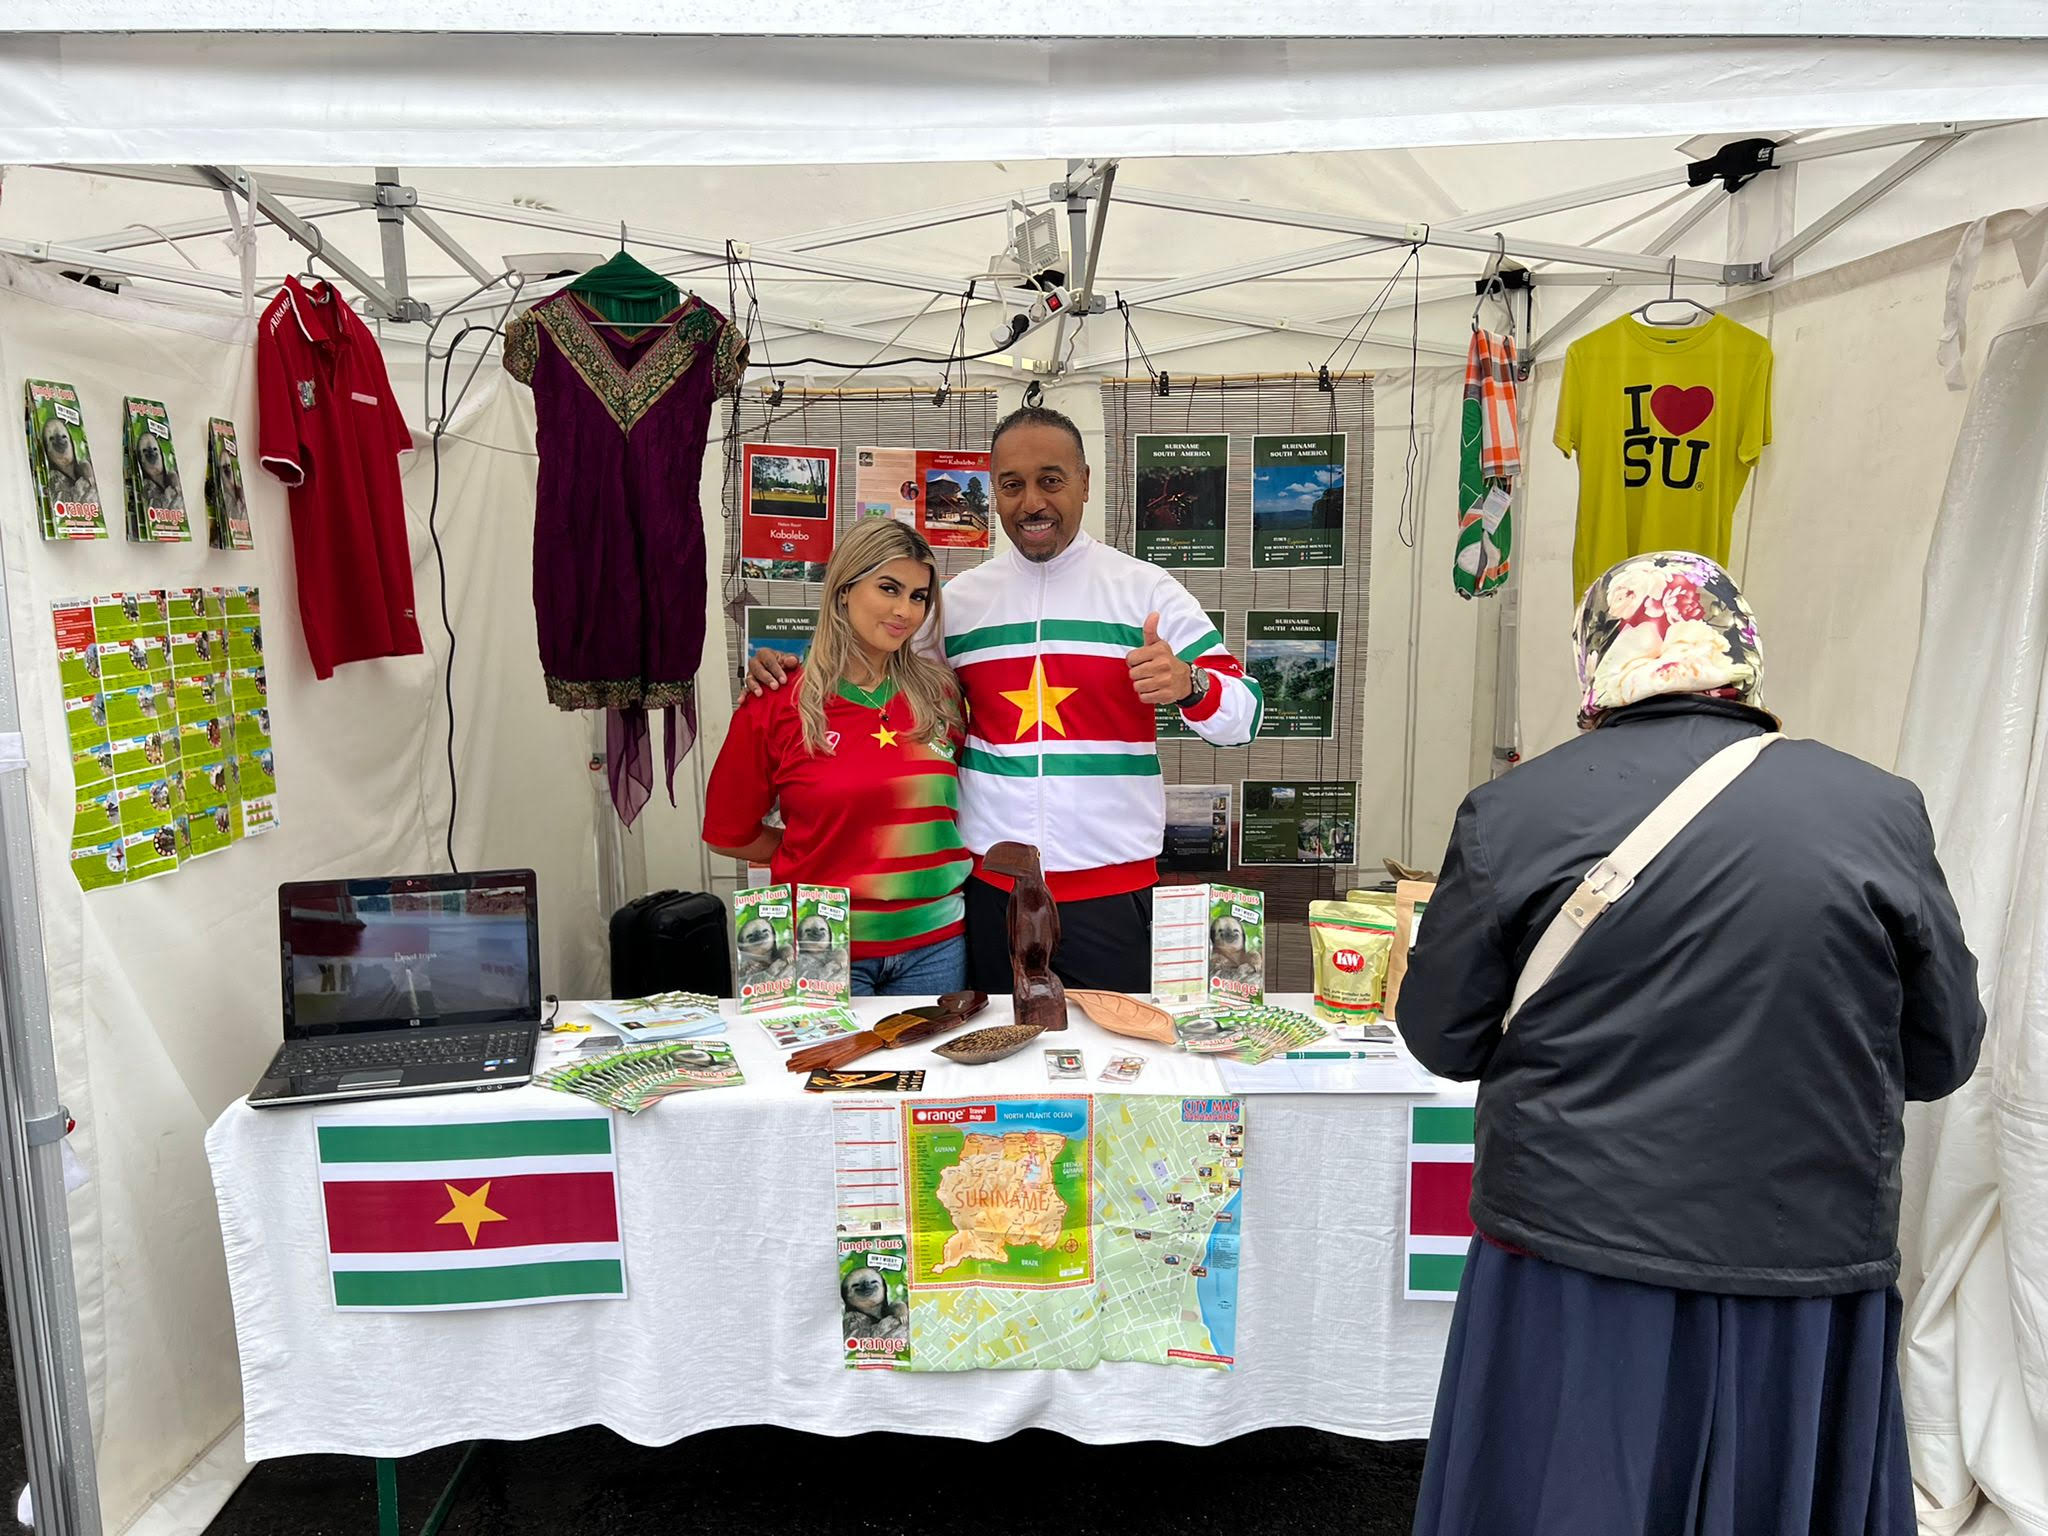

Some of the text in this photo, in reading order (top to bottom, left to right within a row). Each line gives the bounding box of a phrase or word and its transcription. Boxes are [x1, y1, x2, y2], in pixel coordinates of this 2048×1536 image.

[1624, 384, 1652, 437] I
[1623, 435, 1710, 490] SU
[769, 529, 810, 541] Kabalebo
[735, 888, 789, 906] Jungle Tours
[797, 888, 847, 903] Jungle Tours
[1210, 888, 1237, 903] Jungle
[969, 1107, 987, 1115] Travel
[1184, 1100, 1239, 1112] CITY MAP
[969, 1114, 984, 1122] map
[1003, 1111, 1073, 1120] NORTH ATLANTIC OCEAN
[955, 1190, 1049, 1212] SURINAME
[838, 1237, 903, 1254] Jungle Tours
[1021, 1259, 1039, 1267] BRAZIL
